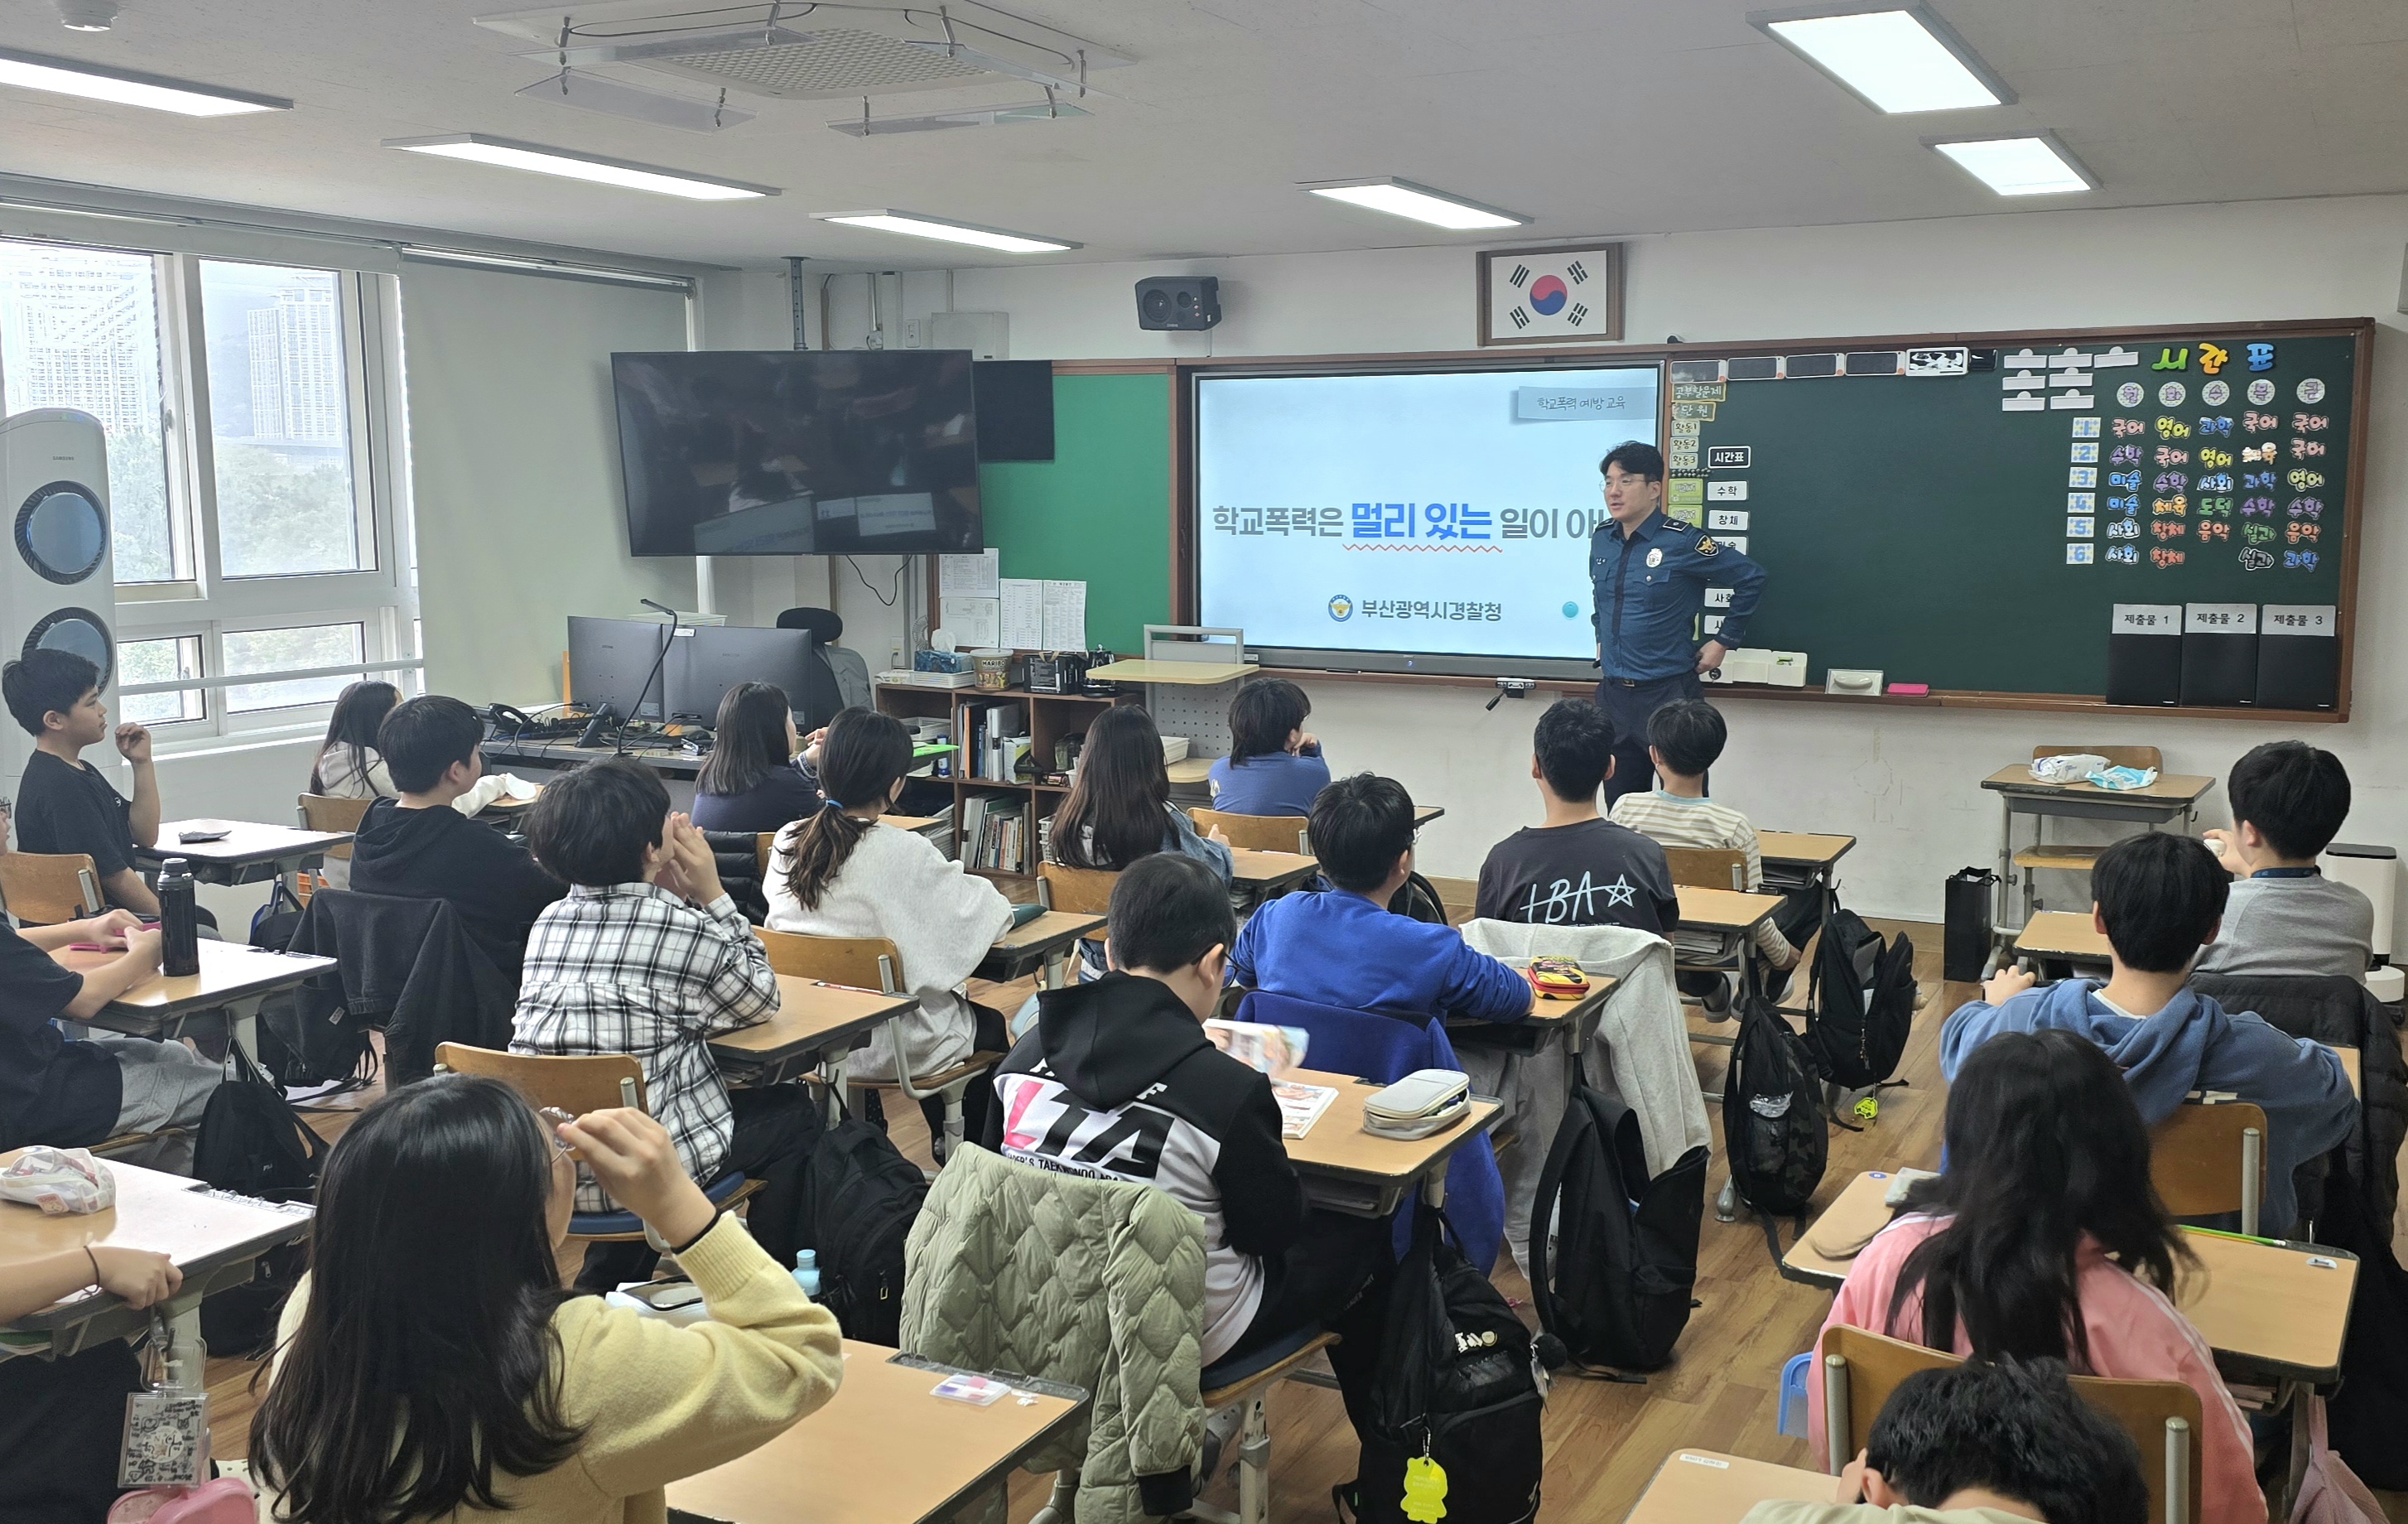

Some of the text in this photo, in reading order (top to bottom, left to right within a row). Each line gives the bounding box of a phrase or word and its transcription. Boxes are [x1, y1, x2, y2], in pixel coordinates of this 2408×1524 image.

[2123, 382, 2319, 404] 월 화 수 목 금
[1537, 396, 1625, 410] 학교폭력 예방 교육
[1675, 422, 1697, 433] 활동1
[2112, 418, 2145, 438] 국어
[2155, 416, 2191, 440] 영어
[2199, 416, 2234, 437] 과학
[2243, 411, 2277, 433] 국어
[2292, 412, 2329, 434] 국어
[1674, 440, 1697, 450] 활동2
[1673, 456, 1696, 466] 활동3
[1714, 451, 1744, 463] 시간표
[2079, 445, 2090, 461] 2
[2110, 444, 2143, 465] 수학
[2155, 446, 2189, 468] 국어
[2199, 447, 2233, 470] 영어
[2290, 438, 2326, 461] 국어
[2078, 468, 2324, 493] 3 미술 수학 사회 과학 영어
[1717, 486, 1737, 496] 수학
[2107, 494, 2140, 516] 미술
[2152, 494, 2187, 517] 체육
[2198, 497, 2233, 517] 도덕
[2241, 497, 2276, 518] 수학
[2287, 497, 2324, 519] 수학
[1212, 503, 1604, 540] 학교폭력은 멀리 있는 일이 아
[1718, 515, 1738, 525] 창체
[2074, 518, 2321, 545] 5 사회 창체 음악 실과 음악
[2074, 543, 2319, 572] 6 사회 창체 실과 과학
[1361, 600, 1501, 622] 부산광역시경찰청
[2124, 614, 2169, 626] 제출물 1
[2197, 613, 2245, 625] 제출물 2
[2274, 615, 2323, 626] 제출물 3
